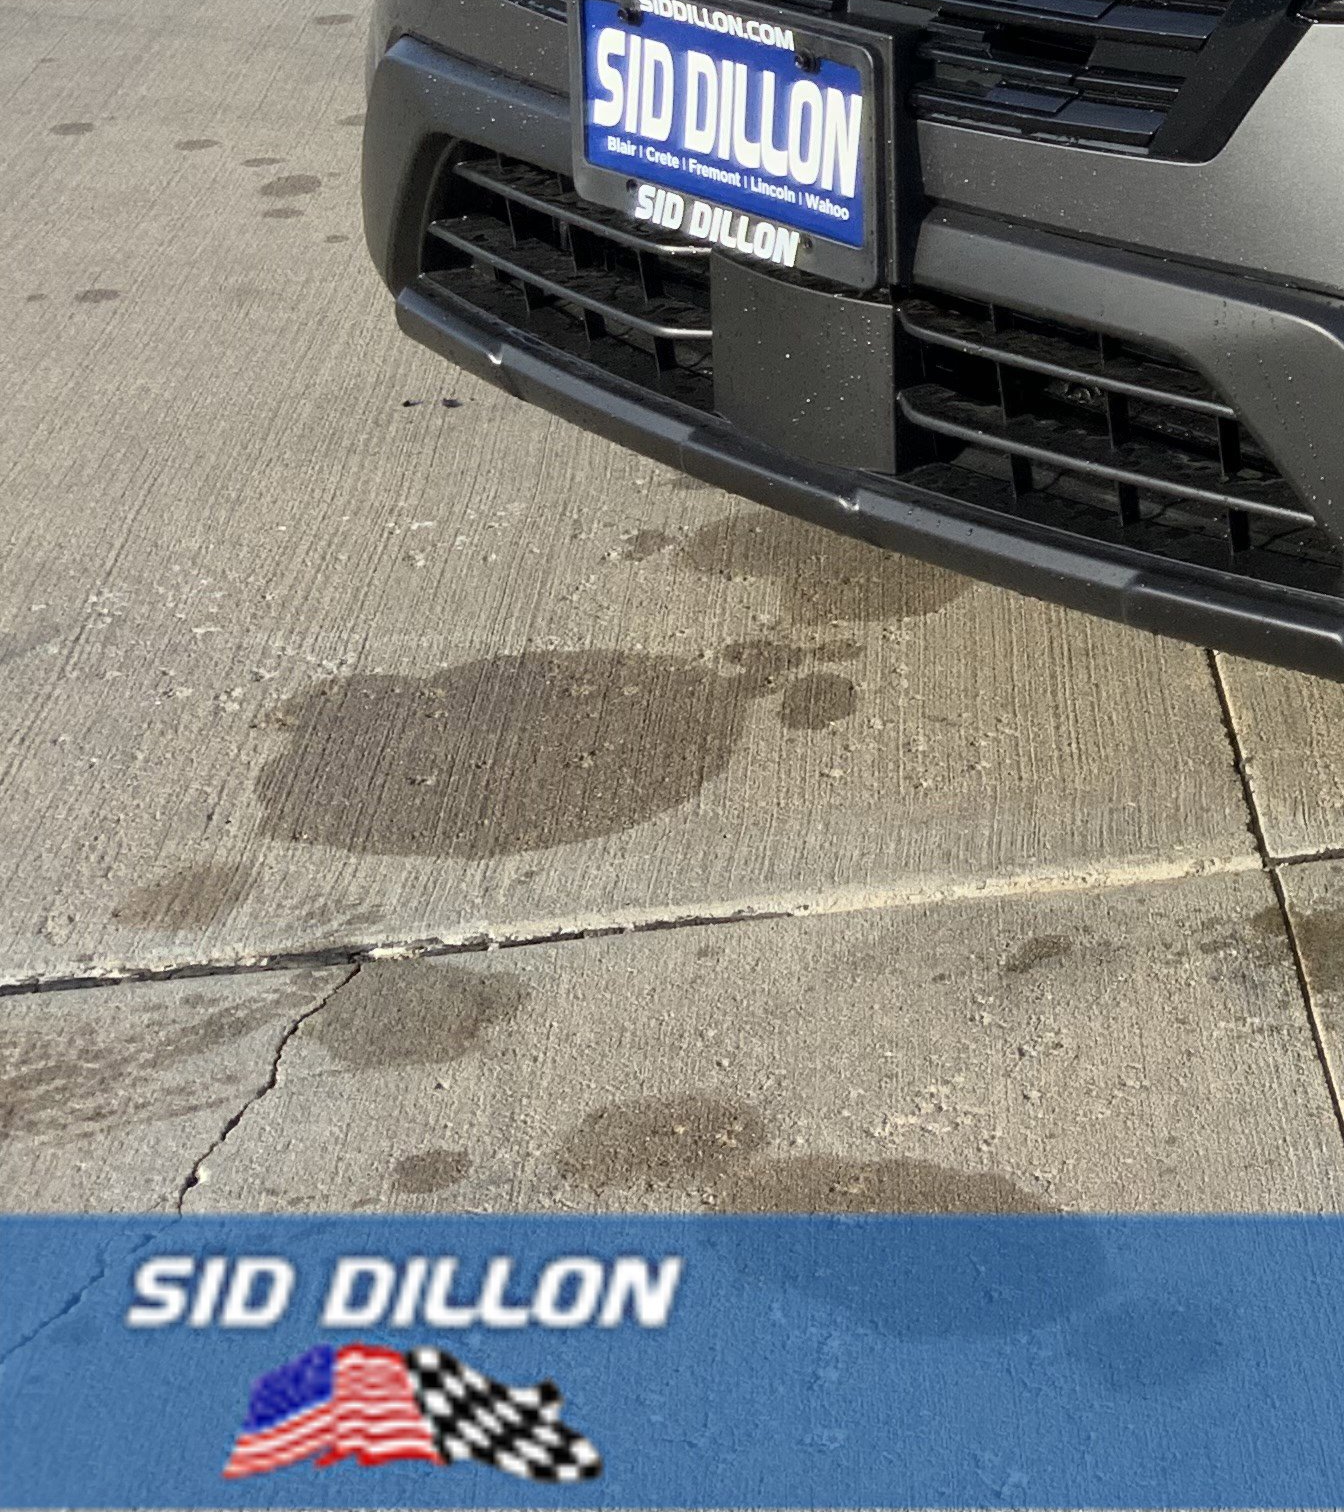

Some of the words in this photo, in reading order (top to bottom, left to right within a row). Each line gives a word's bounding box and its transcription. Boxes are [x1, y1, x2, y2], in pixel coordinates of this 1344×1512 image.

[592, 27, 675, 141] SID
[684, 50, 863, 198] DILLON
[607, 136, 636, 157] Blair
[645, 146, 680, 169] Crete
[688, 158, 741, 188] Fremont
[750, 176, 796, 203] Lincoln
[804, 191, 850, 221] Wahoo
[634, 184, 685, 230] SID
[688, 200, 800, 268] DILLON
